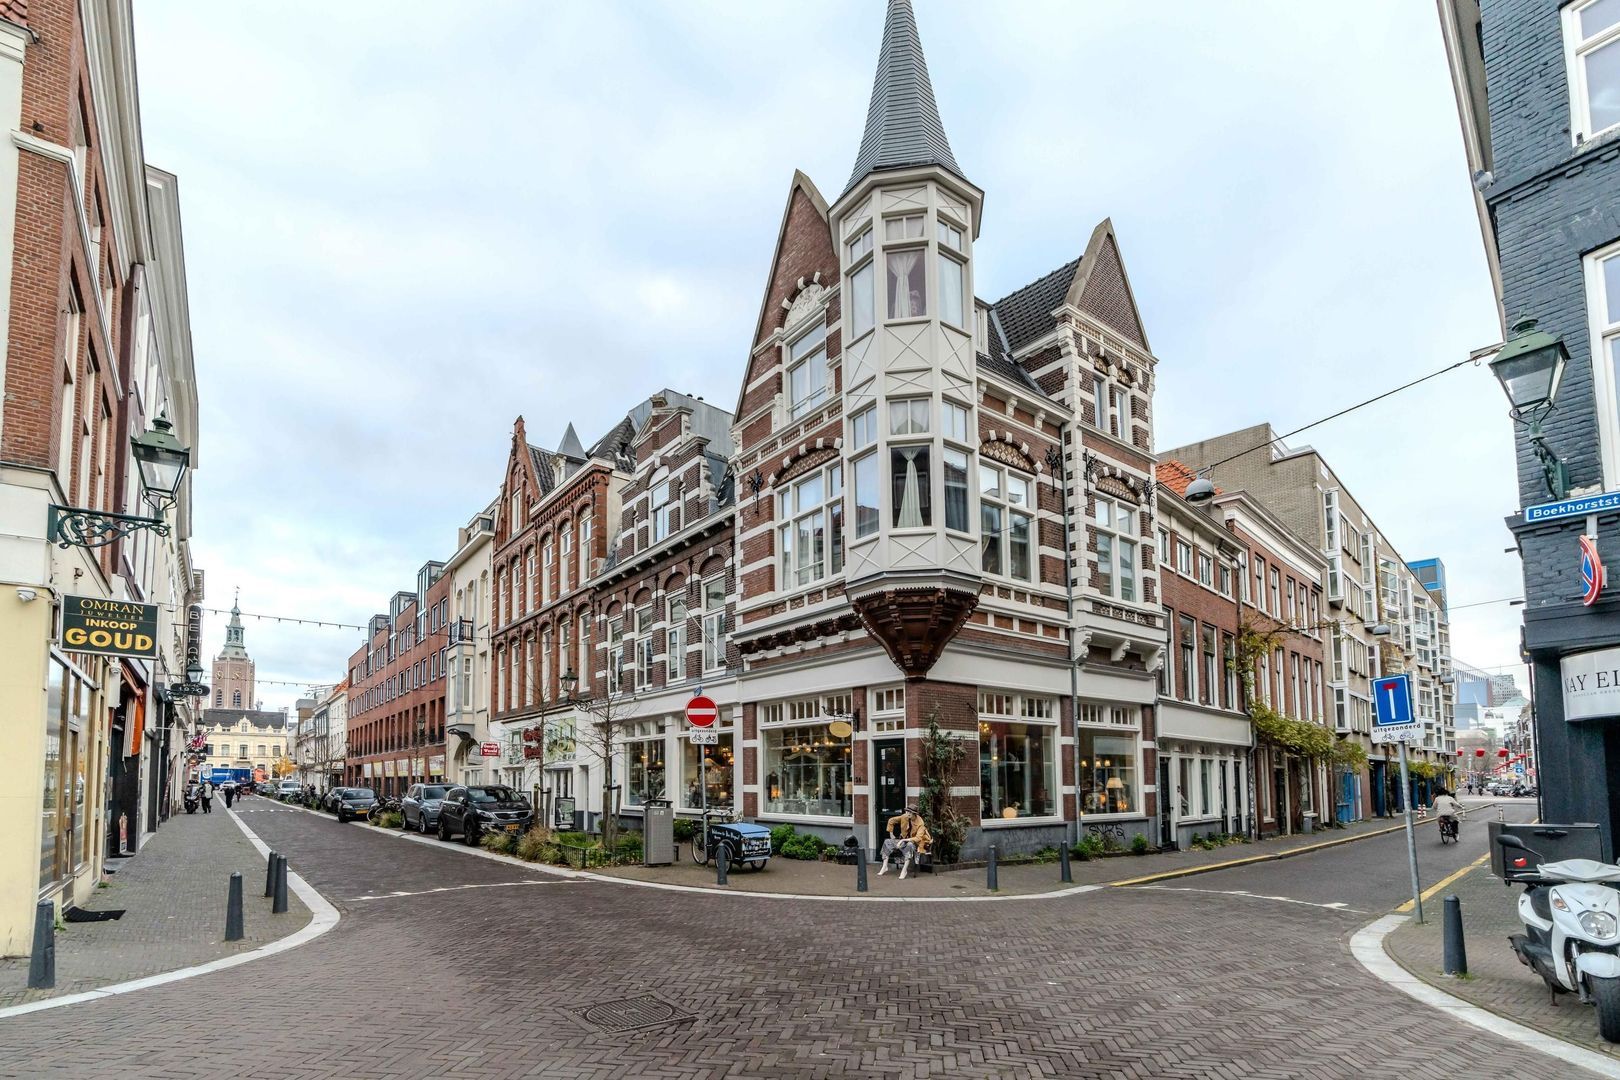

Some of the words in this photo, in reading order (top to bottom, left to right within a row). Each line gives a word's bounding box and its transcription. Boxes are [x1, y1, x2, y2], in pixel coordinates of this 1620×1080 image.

[1533, 496, 1619, 518] Boekhorstst
[80, 599, 144, 615] OMRAN
[80, 610, 144, 621] JUWELIER
[85, 618, 138, 630] INKOOP
[65, 628, 153, 651] GOUD
[1373, 723, 1421, 733] uitgezonderd
